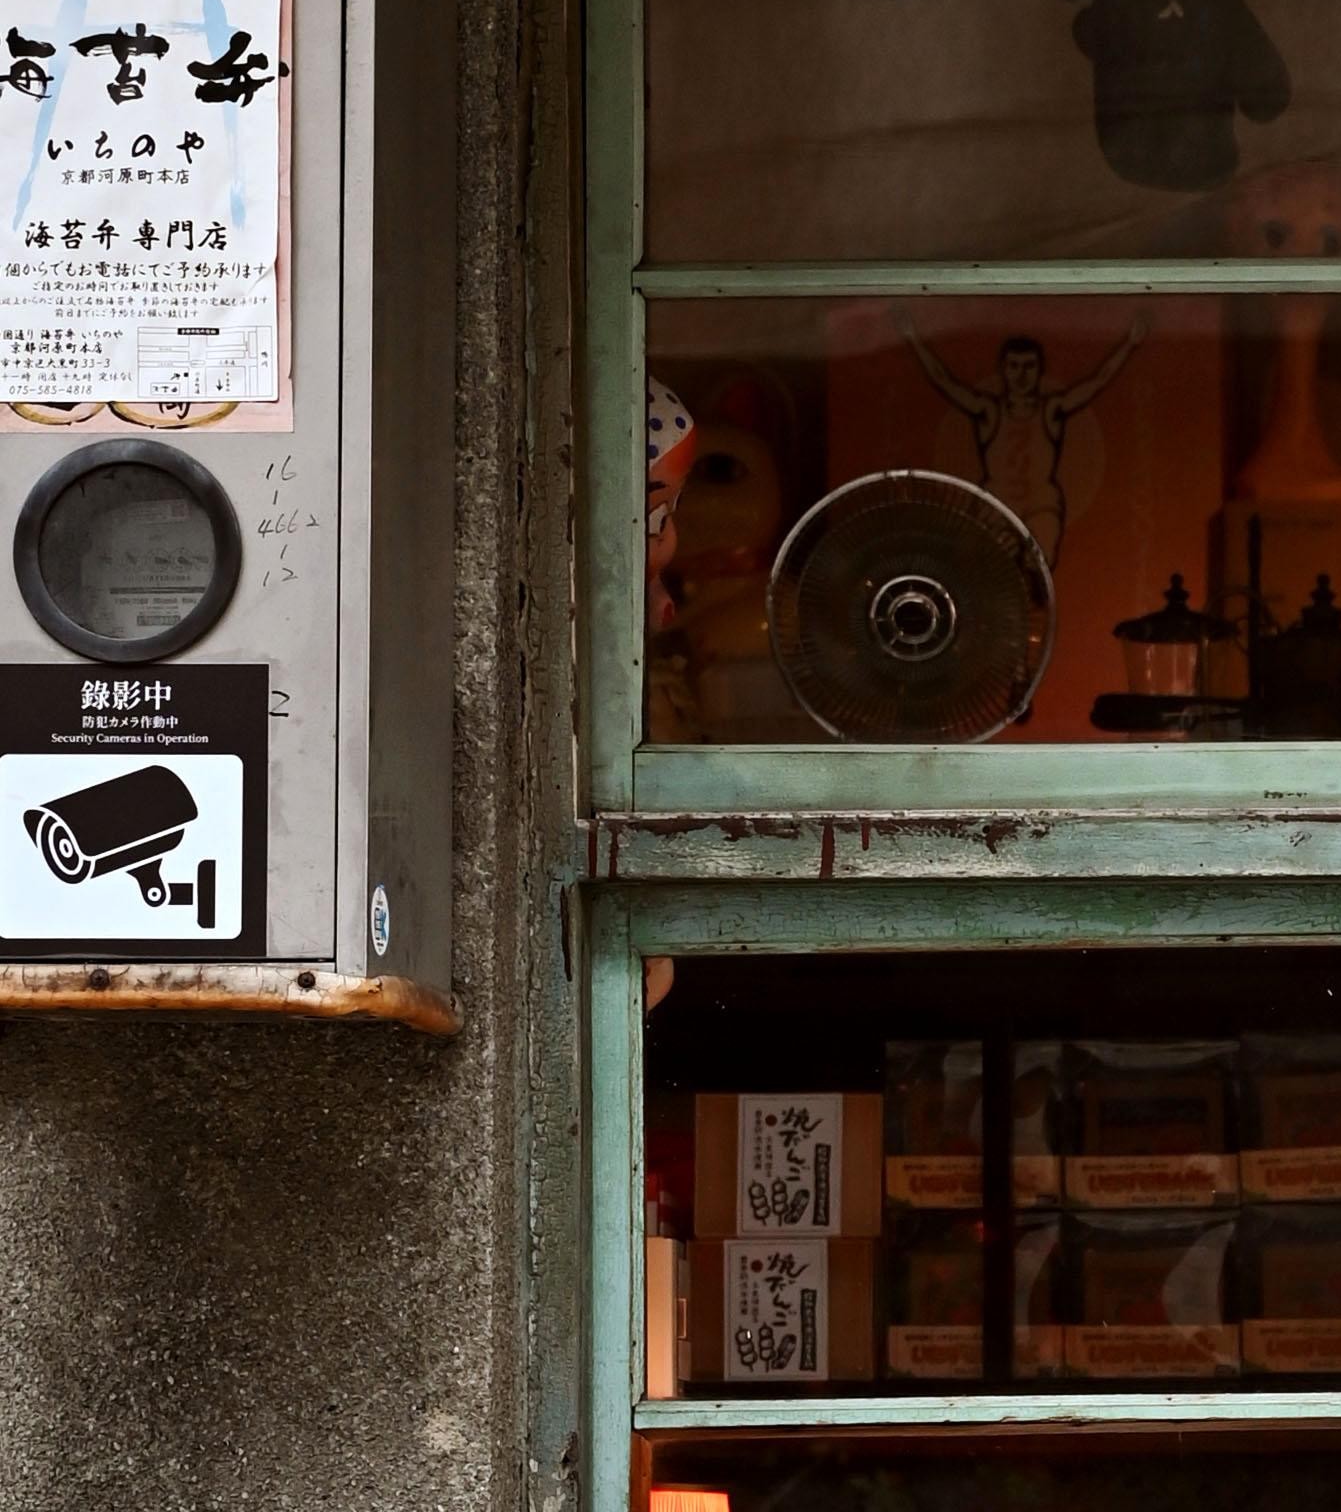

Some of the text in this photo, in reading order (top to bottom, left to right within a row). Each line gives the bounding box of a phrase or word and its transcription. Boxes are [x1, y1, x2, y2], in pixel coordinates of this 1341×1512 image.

[47, 130, 205, 164] いちのや
[61, 167, 190, 185] 京都河原町本店
[25, 219, 228, 251] 海苔弁 専門店
[0, 260, 267, 279] 個からでもお電話にてご予約承ります
[81, 680, 172, 711] 錄影中
[82, 716, 179, 729] 防犯カメラ作動中
[51, 732, 209, 746] Security Cameras in Operation
